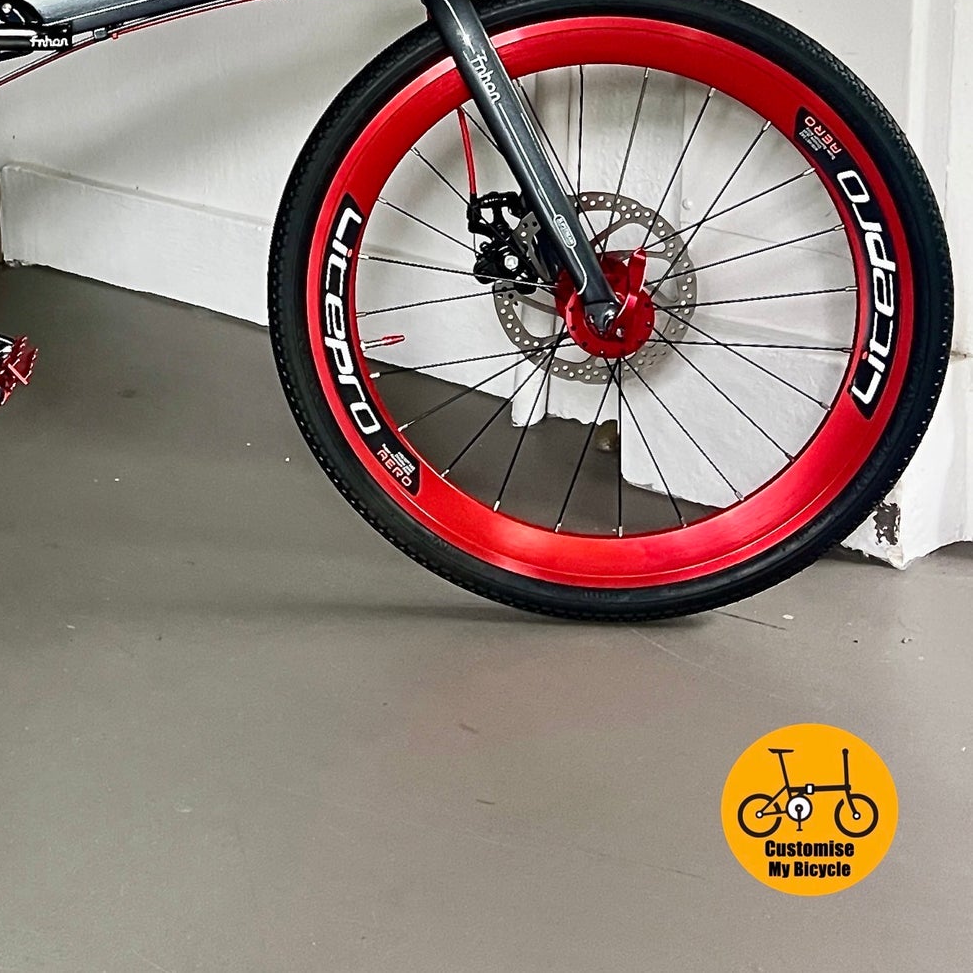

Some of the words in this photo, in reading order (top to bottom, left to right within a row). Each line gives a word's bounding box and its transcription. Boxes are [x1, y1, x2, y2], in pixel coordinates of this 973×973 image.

[804, 115, 842, 154] AERO
[325, 207, 381, 435] Litepro
[837, 170, 896, 405] Litepro
[377, 449, 413, 487] AERO
